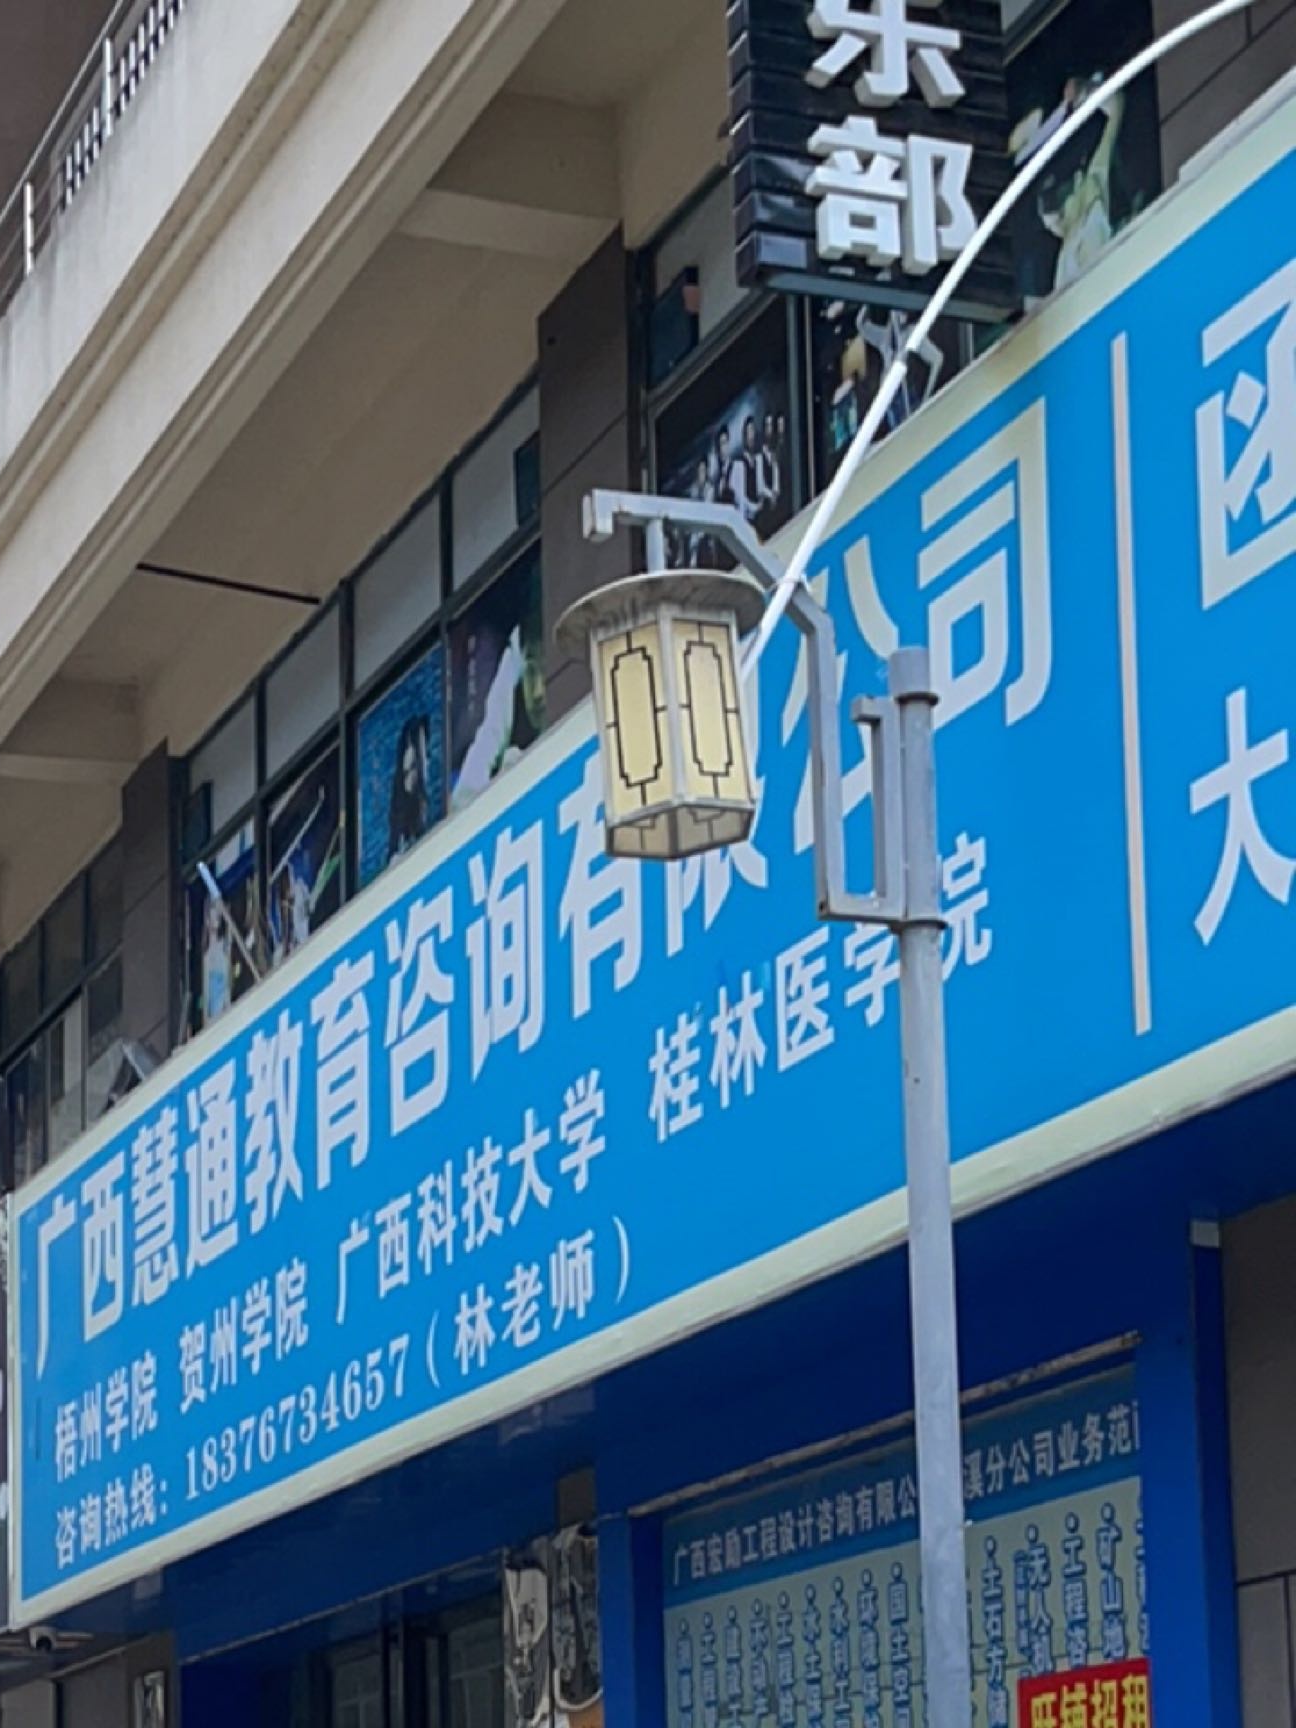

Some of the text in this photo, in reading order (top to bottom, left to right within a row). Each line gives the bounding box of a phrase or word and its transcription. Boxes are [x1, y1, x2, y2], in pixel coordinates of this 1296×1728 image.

[54, 831, 993, 1484] 梧州学院 贺州学院 广西科技大学 桂林医学院
